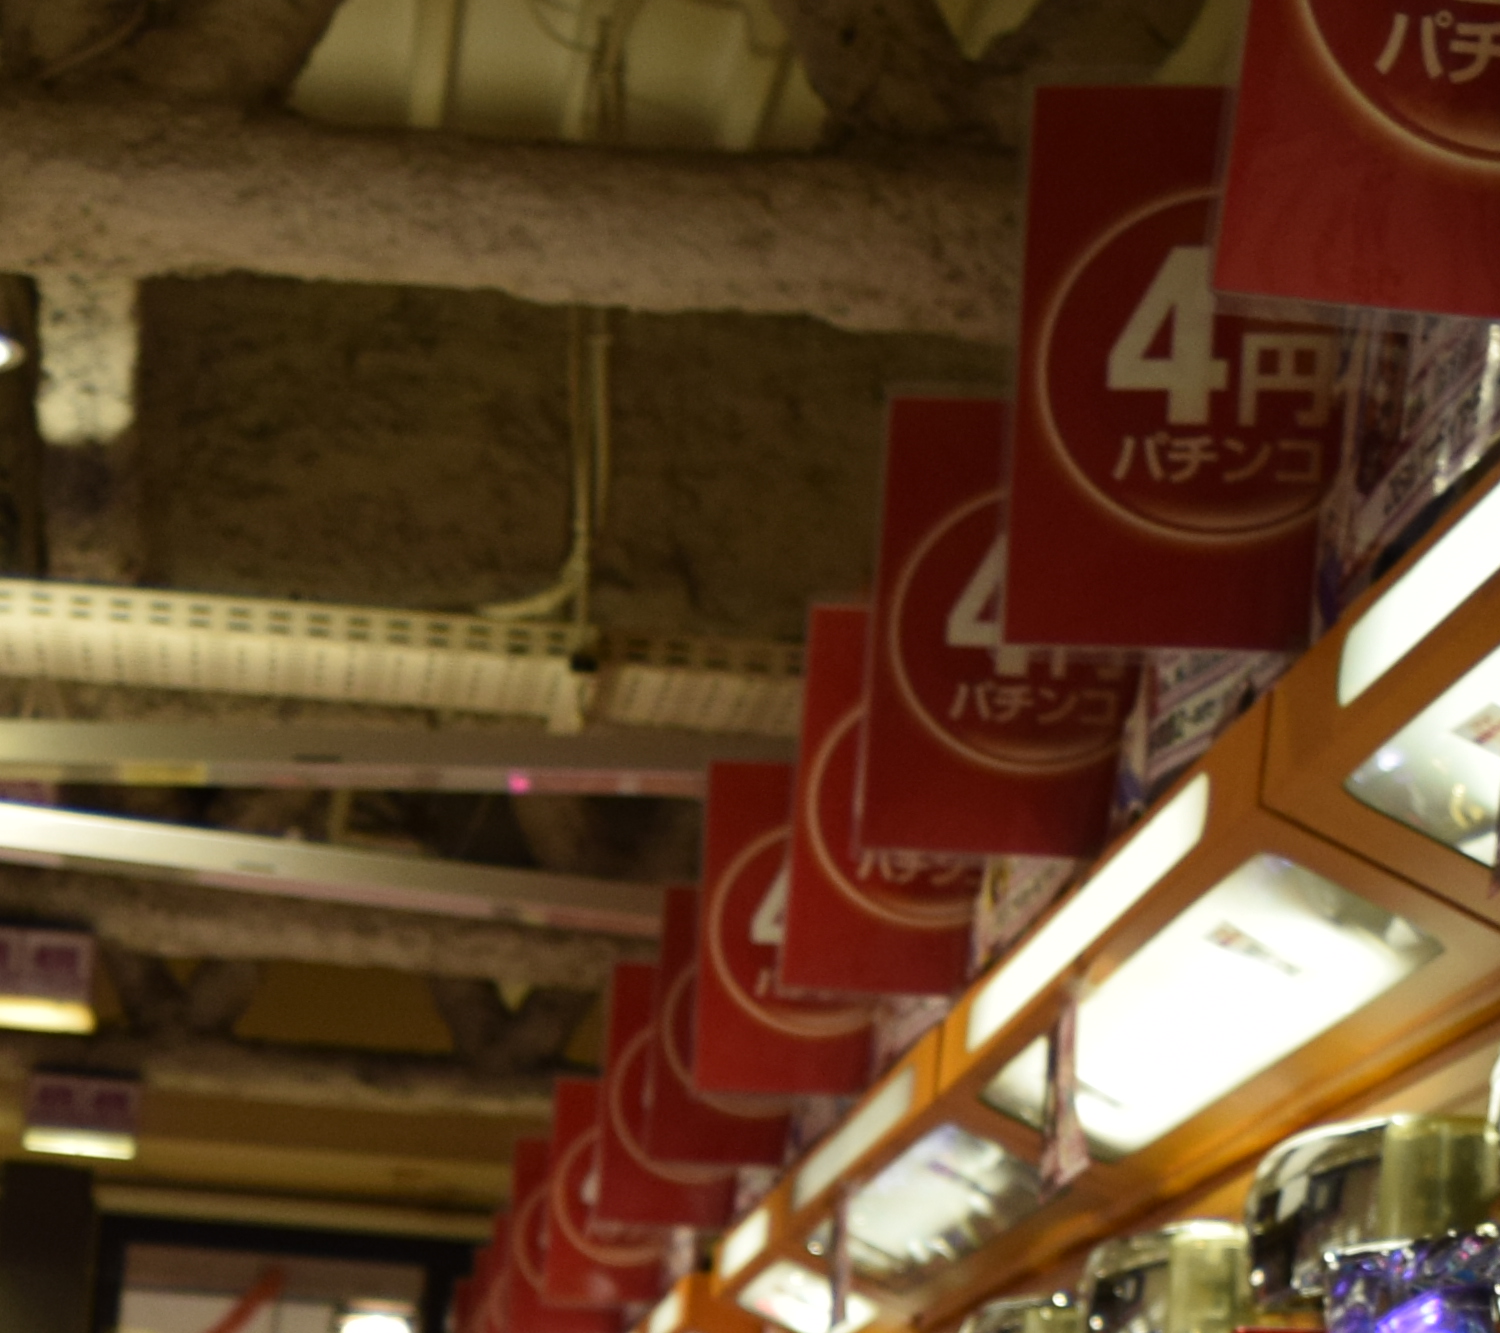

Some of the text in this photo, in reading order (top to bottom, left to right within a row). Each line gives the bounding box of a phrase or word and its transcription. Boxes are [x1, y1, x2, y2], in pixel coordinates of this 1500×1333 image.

[1107, 245, 1336, 428] 4円
[1112, 432, 1322, 484] パチンコ
[949, 683, 1119, 724] パチンコ
